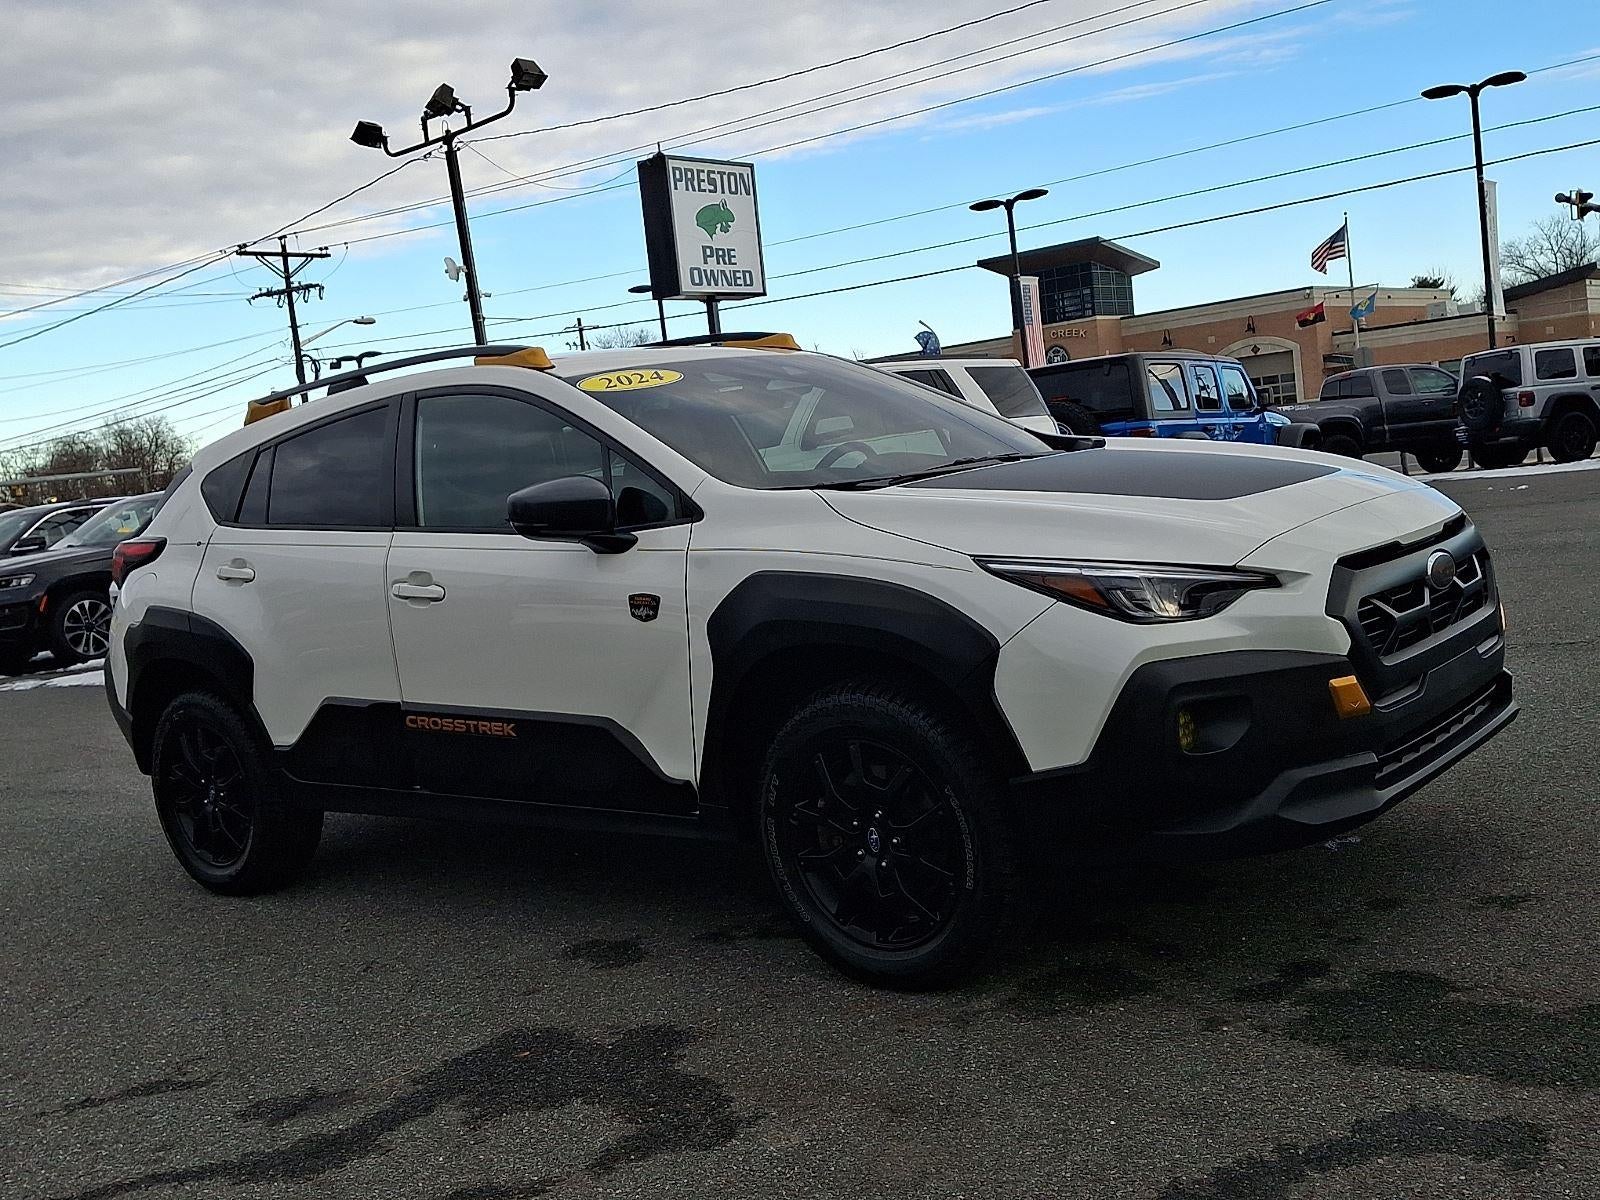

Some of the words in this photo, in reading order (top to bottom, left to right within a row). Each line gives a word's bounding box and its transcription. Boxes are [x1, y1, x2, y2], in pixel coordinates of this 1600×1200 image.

[671, 166, 751, 196] PRESTON
[701, 245, 738, 266] PRE
[689, 267, 754, 287] OWNED
[1050, 328, 1088, 338] CREEK
[598, 371, 664, 389] 2024
[405, 715, 517, 737] CROSSTREK
